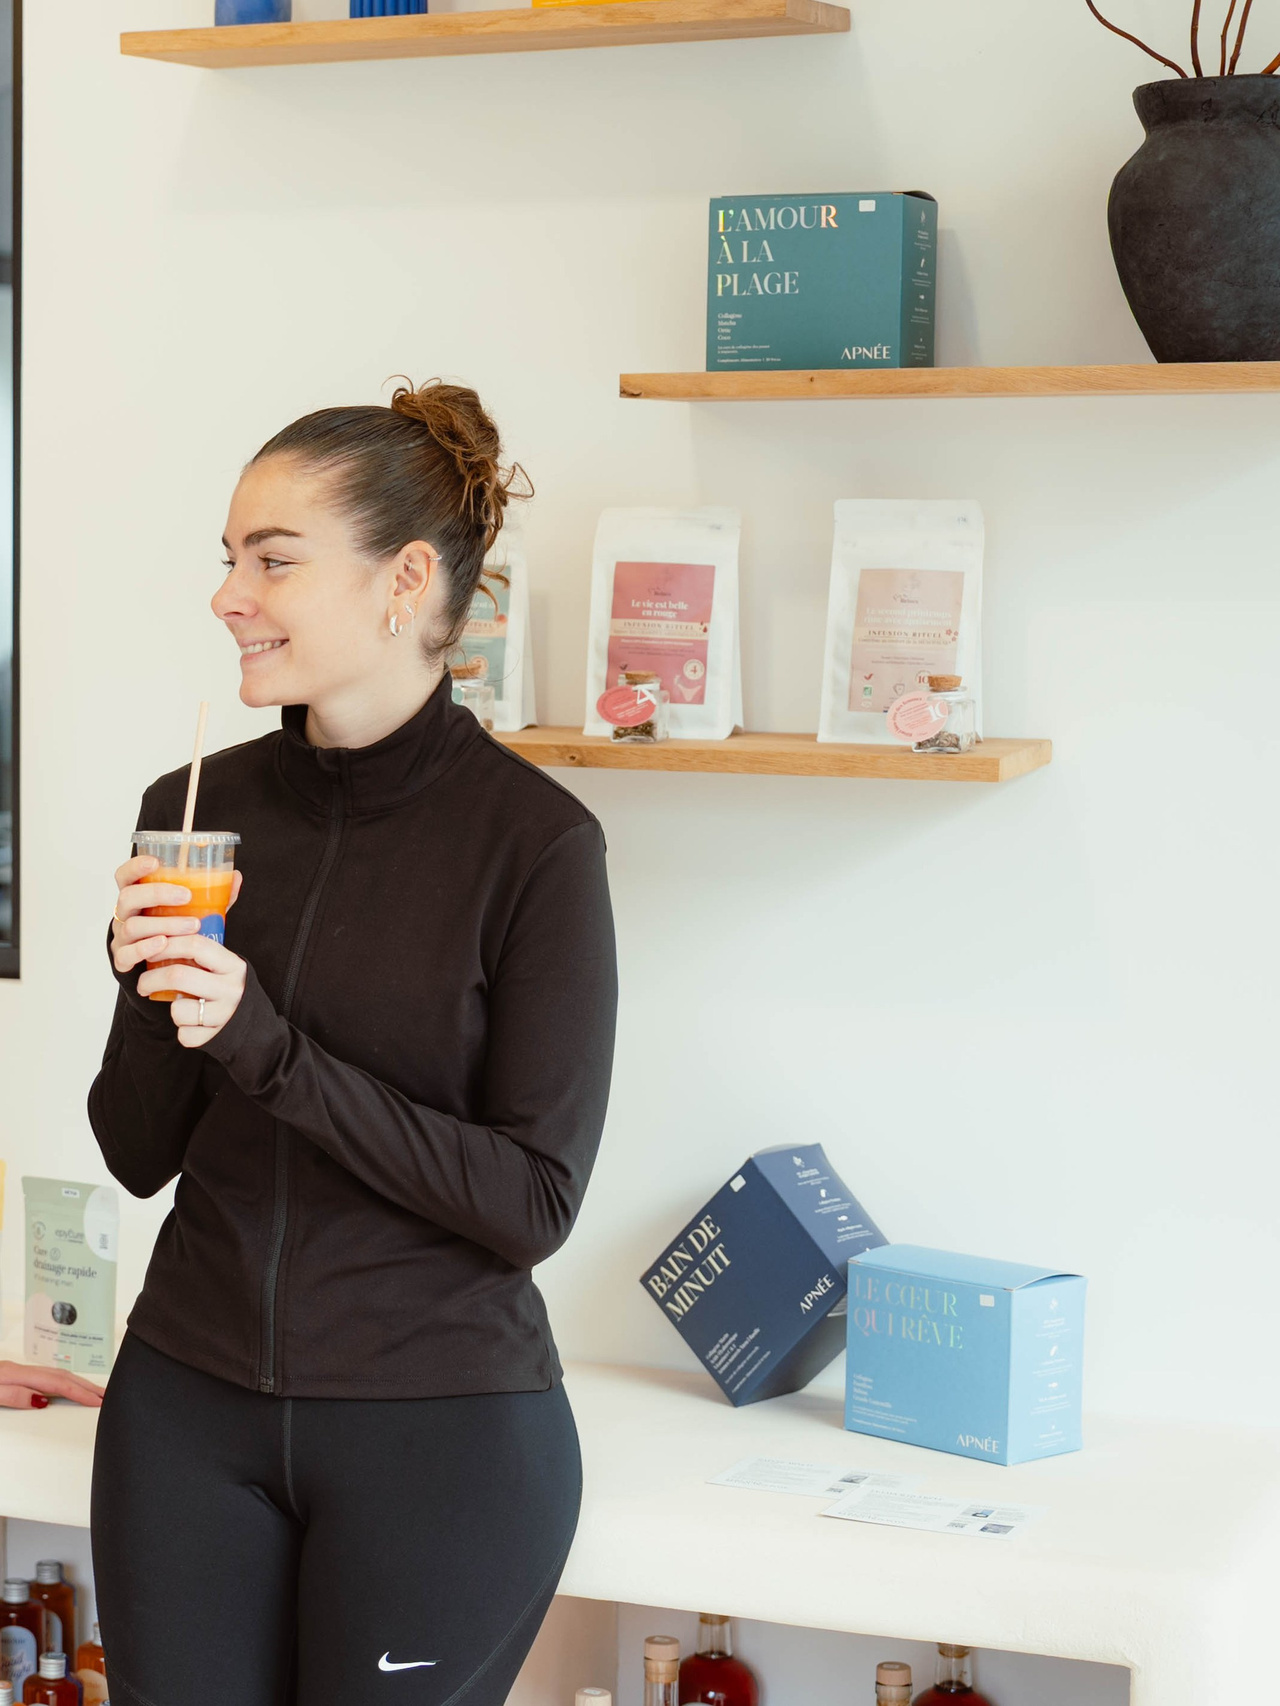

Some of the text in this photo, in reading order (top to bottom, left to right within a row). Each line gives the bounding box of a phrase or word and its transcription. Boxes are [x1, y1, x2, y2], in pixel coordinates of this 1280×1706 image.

[717, 205, 839, 233] L’AMOUR
[716, 235, 775, 265] À LA
[716, 271, 800, 297] PLAGE
[840, 343, 892, 361] APNÉE
[655, 600, 667, 609] est
[668, 600, 689, 610] belle
[648, 1214, 721, 1299] BAIN DE
[67, 1266, 98, 1280] rapide
[665, 1243, 732, 1322] MINUIT
[799, 1273, 835, 1315] APNÉE
[855, 1274, 881, 1303] LE
[853, 1306, 964, 1350] QUI RÊVE
[956, 1434, 1000, 1455] APNÉE
